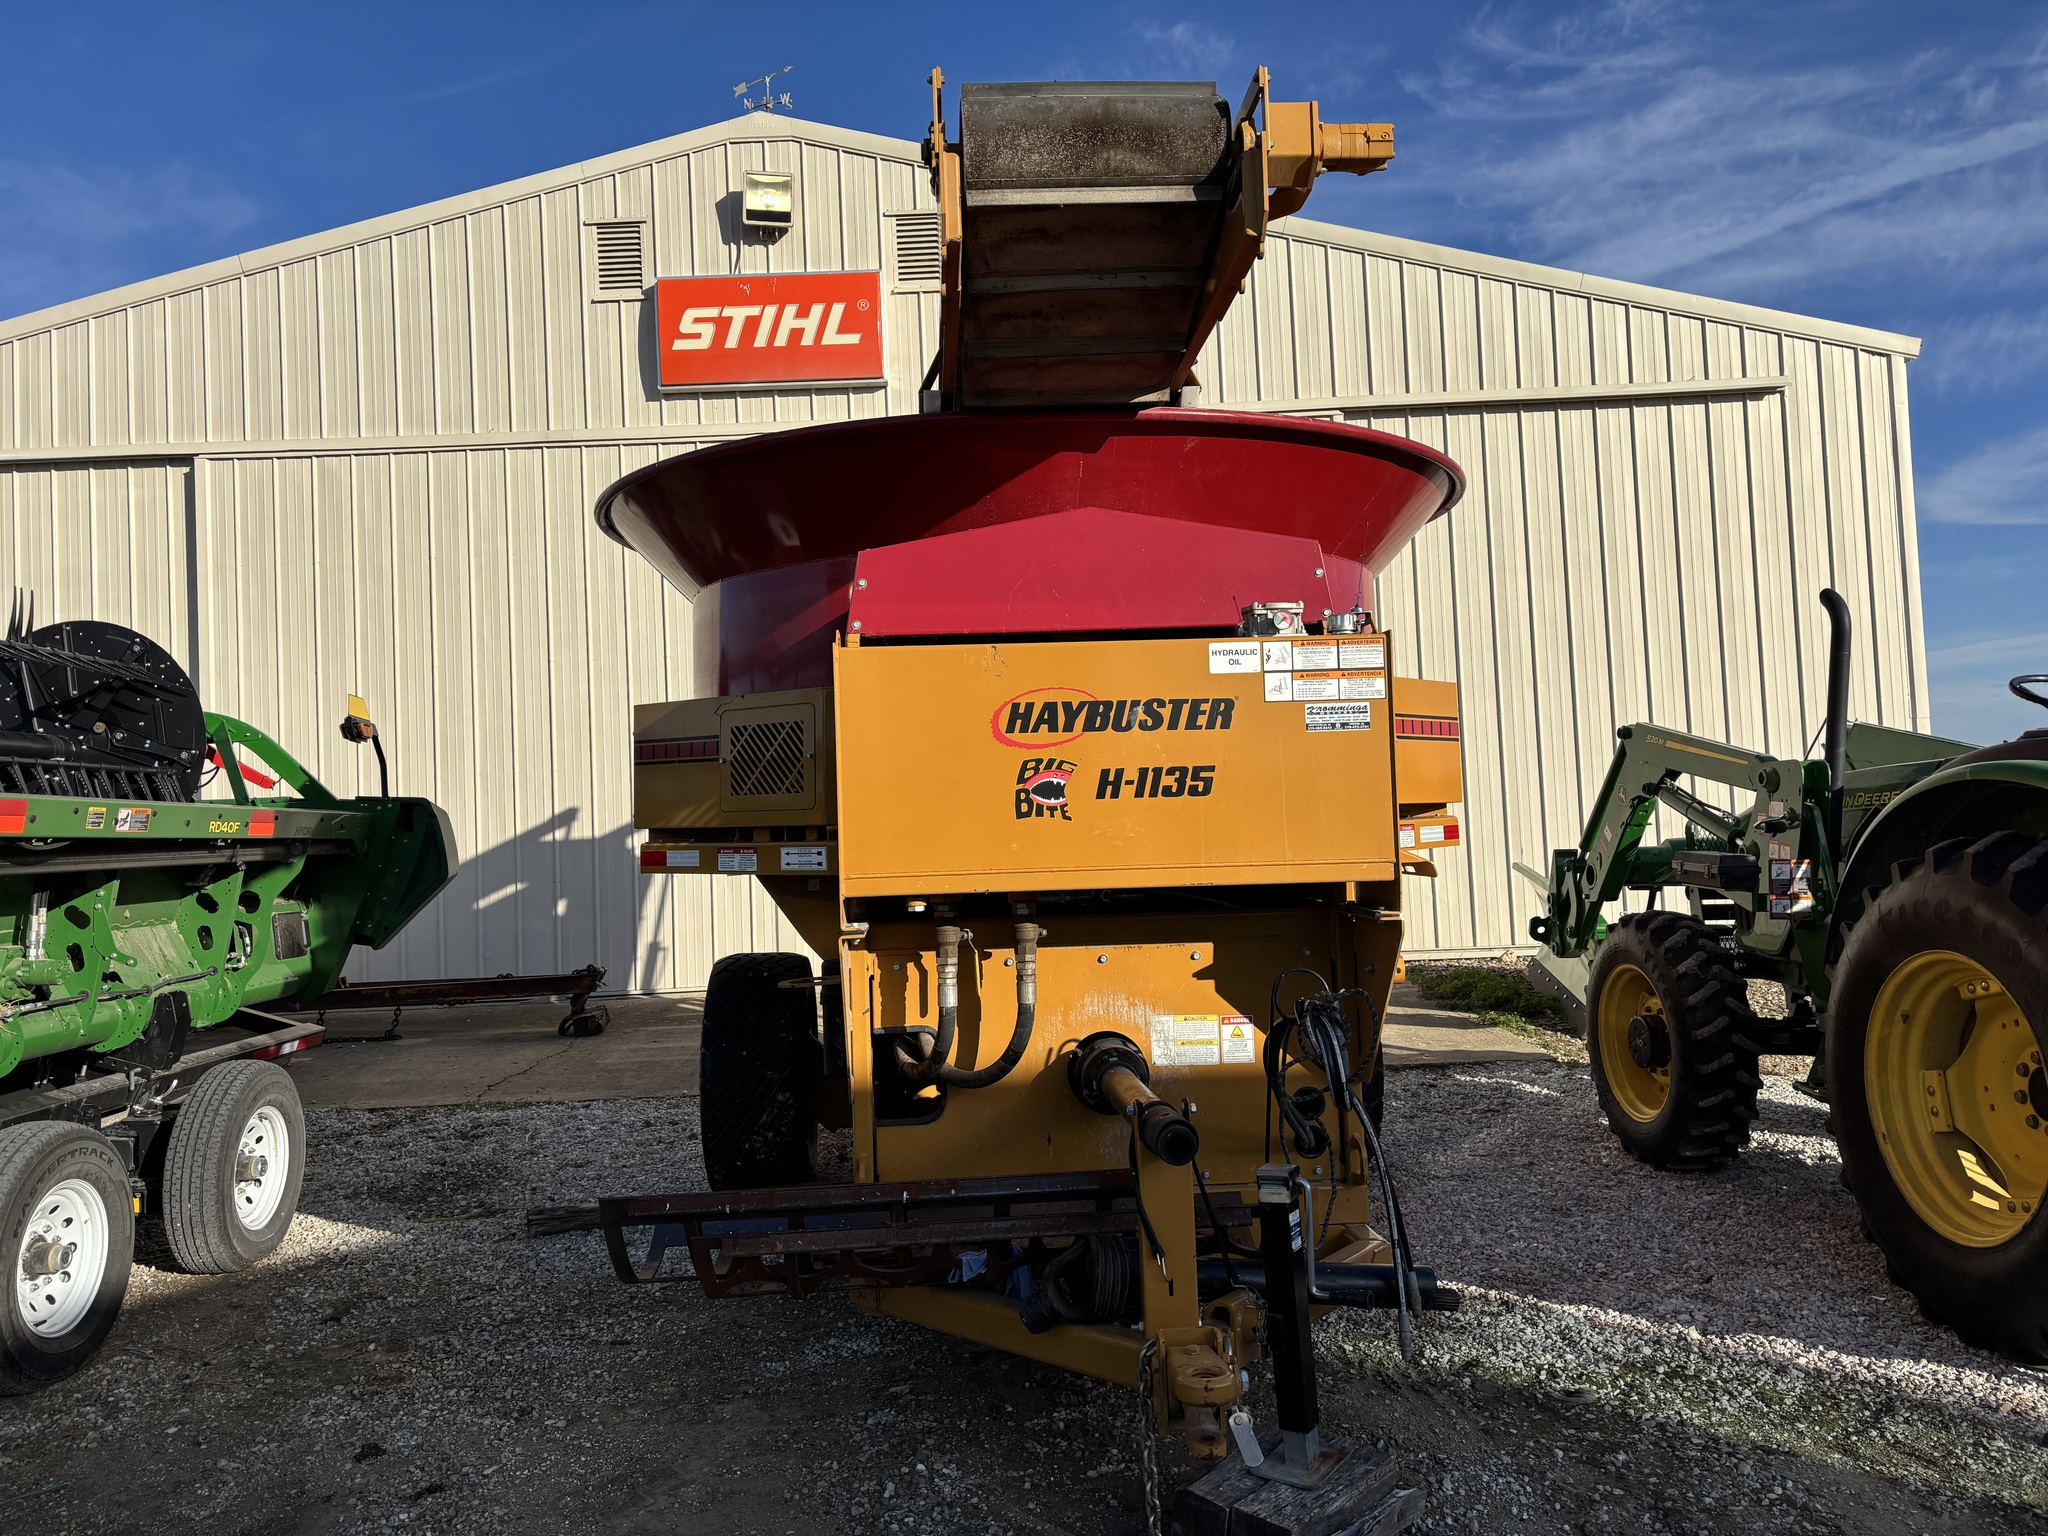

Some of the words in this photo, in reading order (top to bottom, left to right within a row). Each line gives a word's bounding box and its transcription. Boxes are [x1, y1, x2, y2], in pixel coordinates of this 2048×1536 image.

[672, 302, 863, 350] STIHL
[1211, 649, 1258, 657] HYDRAULIC
[1228, 658, 1242, 666] OIL
[1005, 698, 1235, 734] HAYBUSTER
[1016, 758, 1078, 786] BIG
[1095, 765, 1216, 799] H-1135
[1015, 788, 1073, 821] BITE
[208, 821, 241, 834] RD40F
